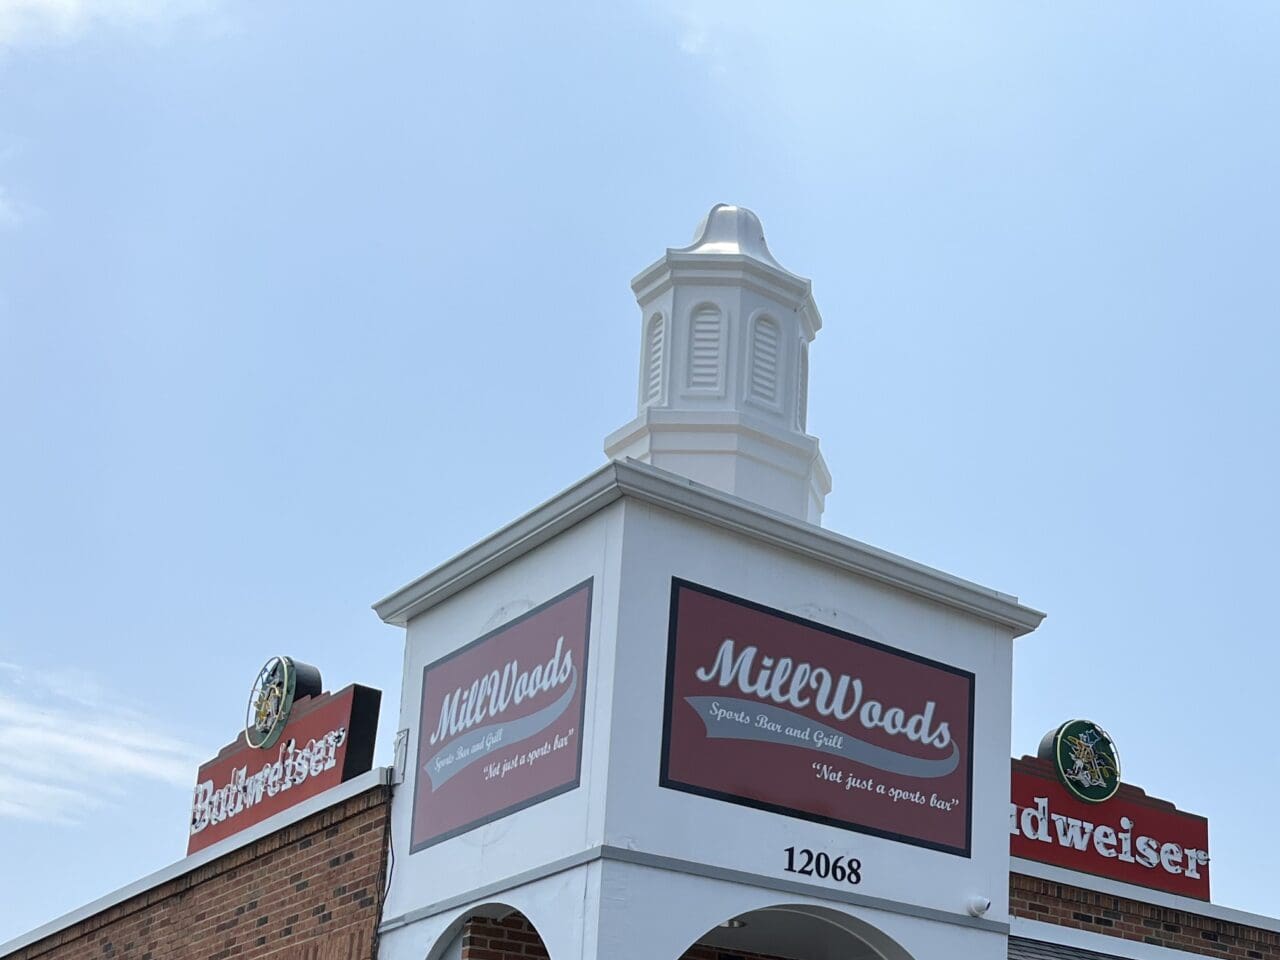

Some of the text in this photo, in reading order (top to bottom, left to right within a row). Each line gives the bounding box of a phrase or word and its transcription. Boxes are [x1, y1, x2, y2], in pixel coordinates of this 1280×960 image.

[430, 635, 572, 745] MillWoods
[696, 639, 951, 748] MillWoods
[709, 701, 844, 750] Sports Bar and Grill
[191, 727, 347, 834] Budweiser
[501, 754, 519, 778] just
[519, 755, 526, 765] a
[526, 741, 551, 766] sports
[845, 772, 873, 791] just
[876, 784, 886, 794] a
[888, 785, 926, 806] sports
[784, 846, 862, 884] 12068
[1010, 797, 1210, 879] dweiser
